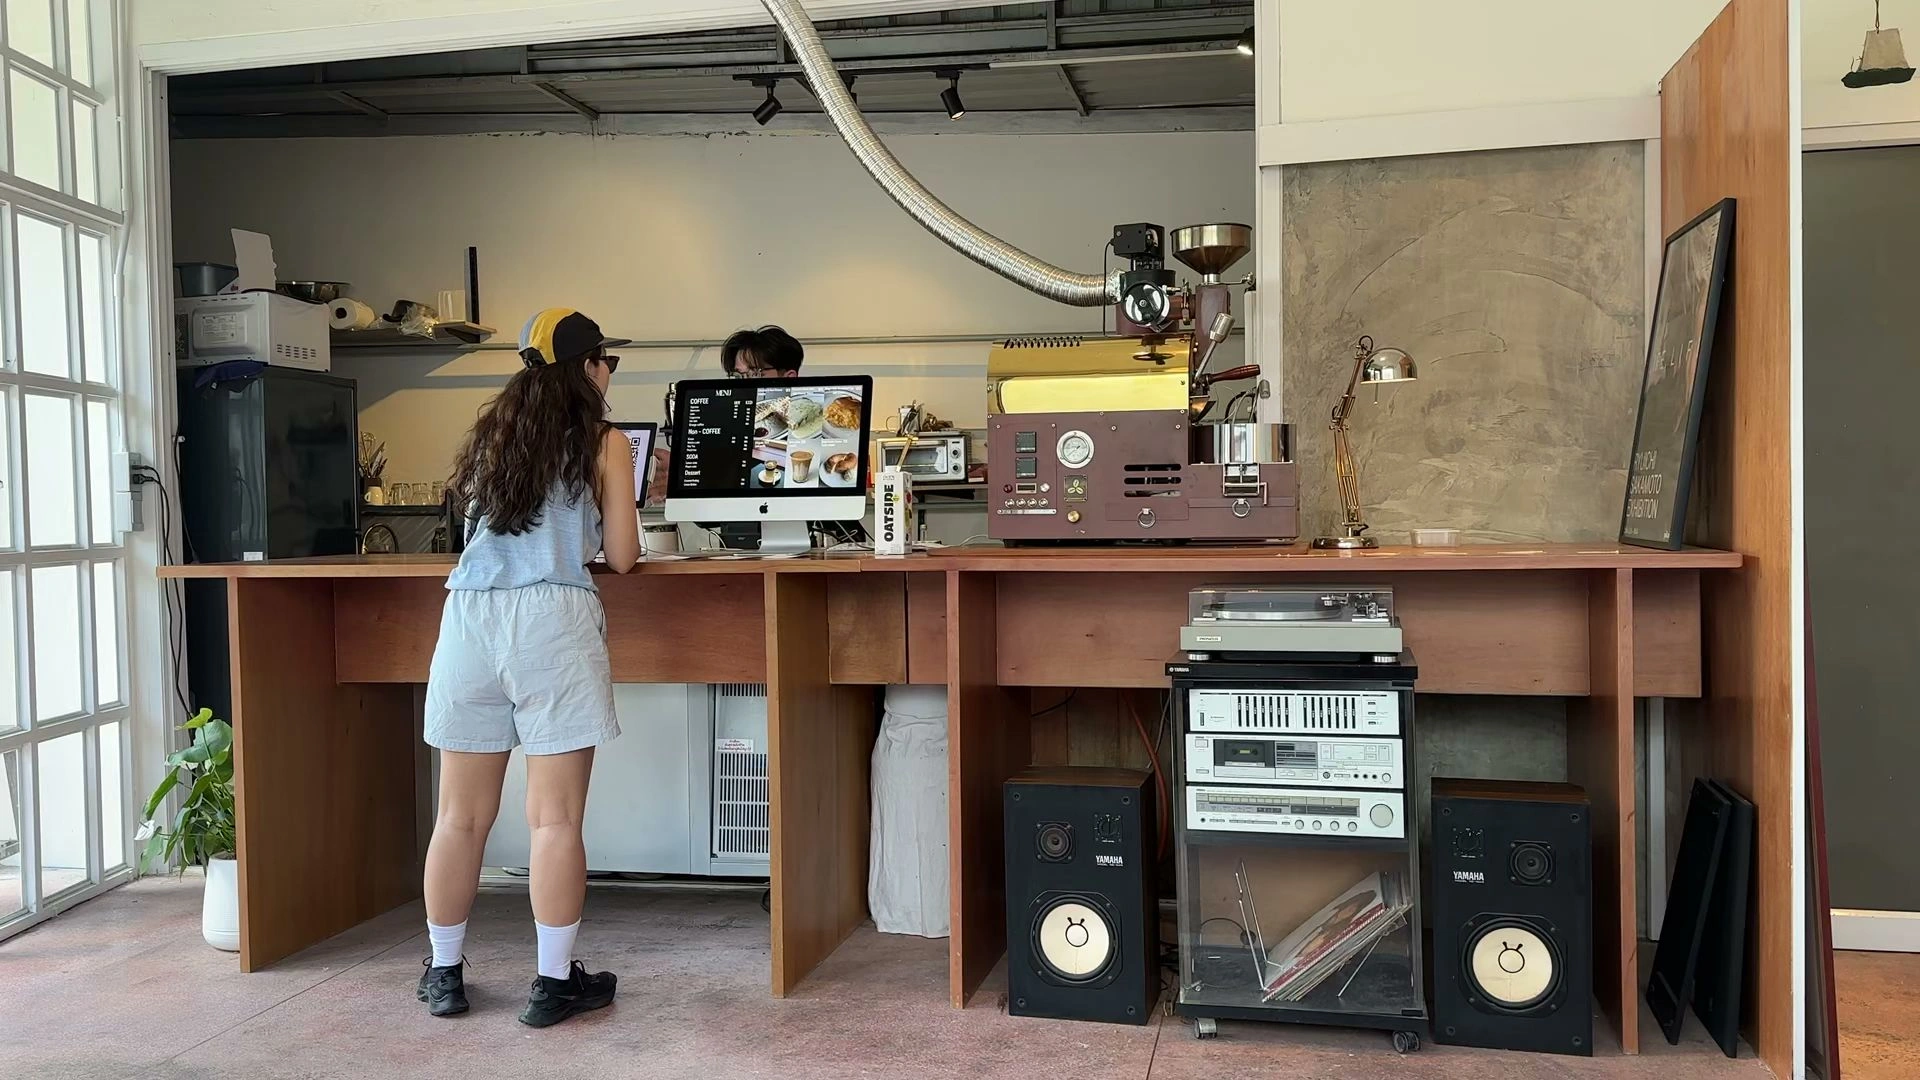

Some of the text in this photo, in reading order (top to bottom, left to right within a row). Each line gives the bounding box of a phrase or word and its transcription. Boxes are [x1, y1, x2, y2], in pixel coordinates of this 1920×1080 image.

[1630, 474, 1662, 494] SAKAMOTO
[884, 484, 894, 542] OATSIDE
[1095, 855, 1123, 864] YAMAHA
[1453, 871, 1484, 881] YAMAHA
